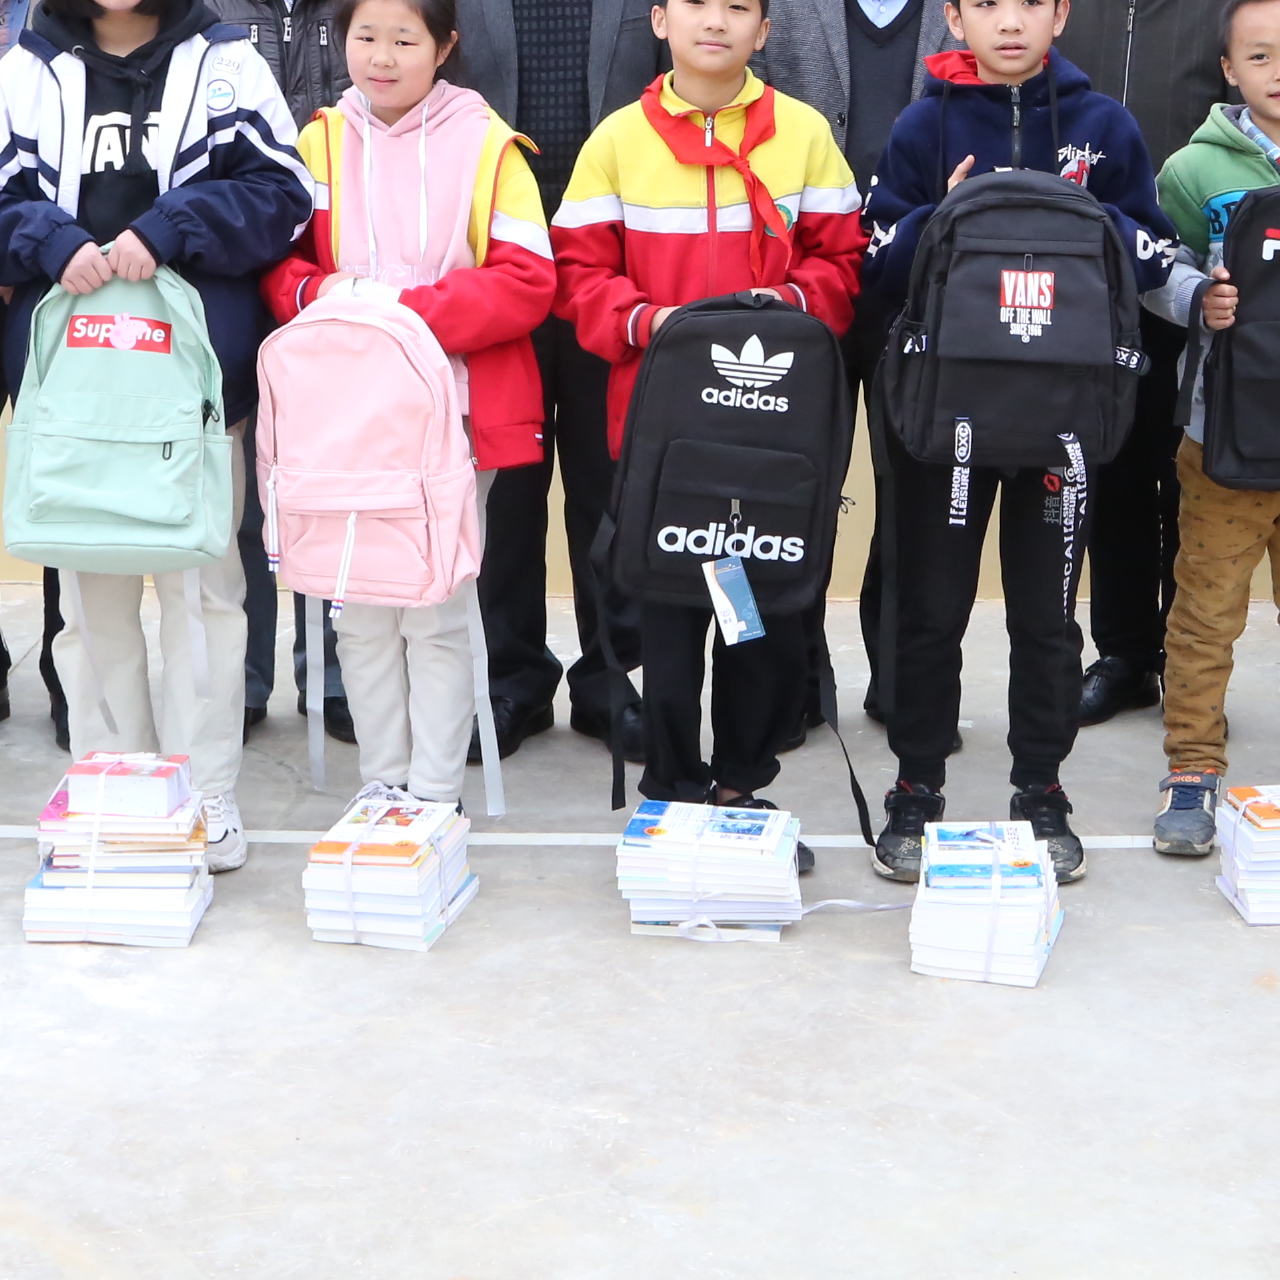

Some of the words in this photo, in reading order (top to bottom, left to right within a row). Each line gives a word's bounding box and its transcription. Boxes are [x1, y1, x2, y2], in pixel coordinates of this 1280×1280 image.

[1003, 271, 1053, 308] VANS
[1000, 307, 1015, 323] OFF
[1016, 308, 1031, 324] THE
[1031, 309, 1052, 325] WALL
[1009, 323, 1027, 335] SINCE
[73, 317, 166, 343] Supme
[701, 387, 789, 412] adidas
[1043, 494, 1061, 524] 抖音
[657, 522, 805, 562] adidas
